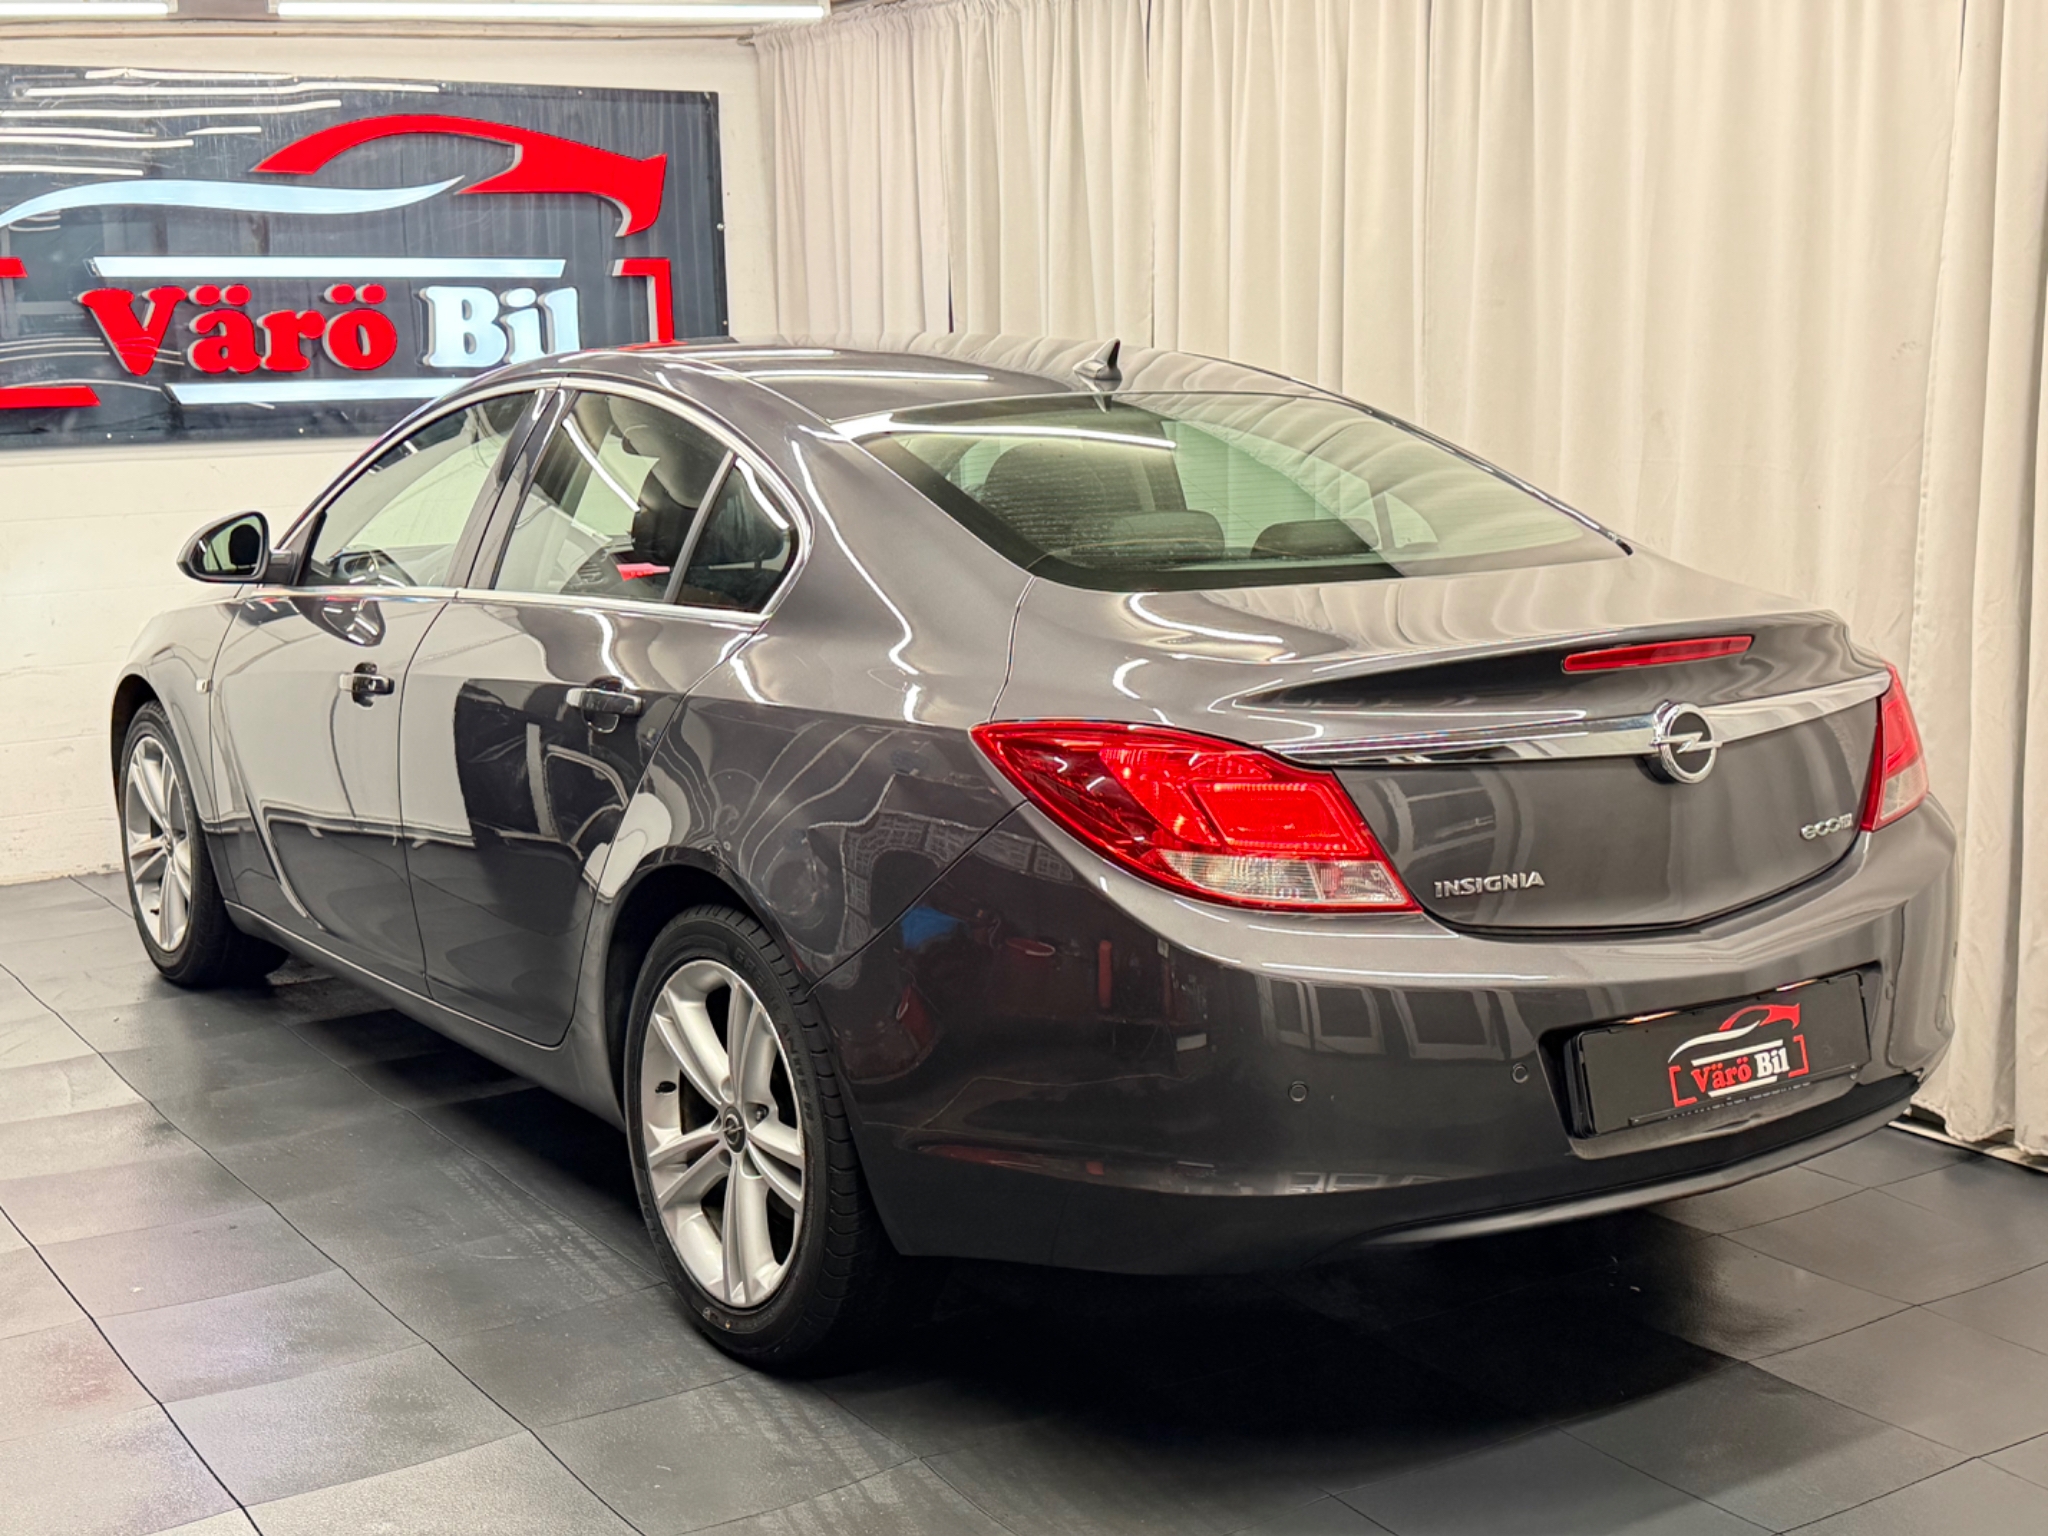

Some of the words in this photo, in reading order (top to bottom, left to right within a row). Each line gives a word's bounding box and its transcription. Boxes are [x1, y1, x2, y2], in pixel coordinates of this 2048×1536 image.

[79, 284, 397, 376] Värö
[418, 286, 580, 367] Bil
[1434, 871, 1545, 898] INSIGNIA
[1691, 1056, 1752, 1093] Värö
[1754, 1047, 1790, 1078] Bil
